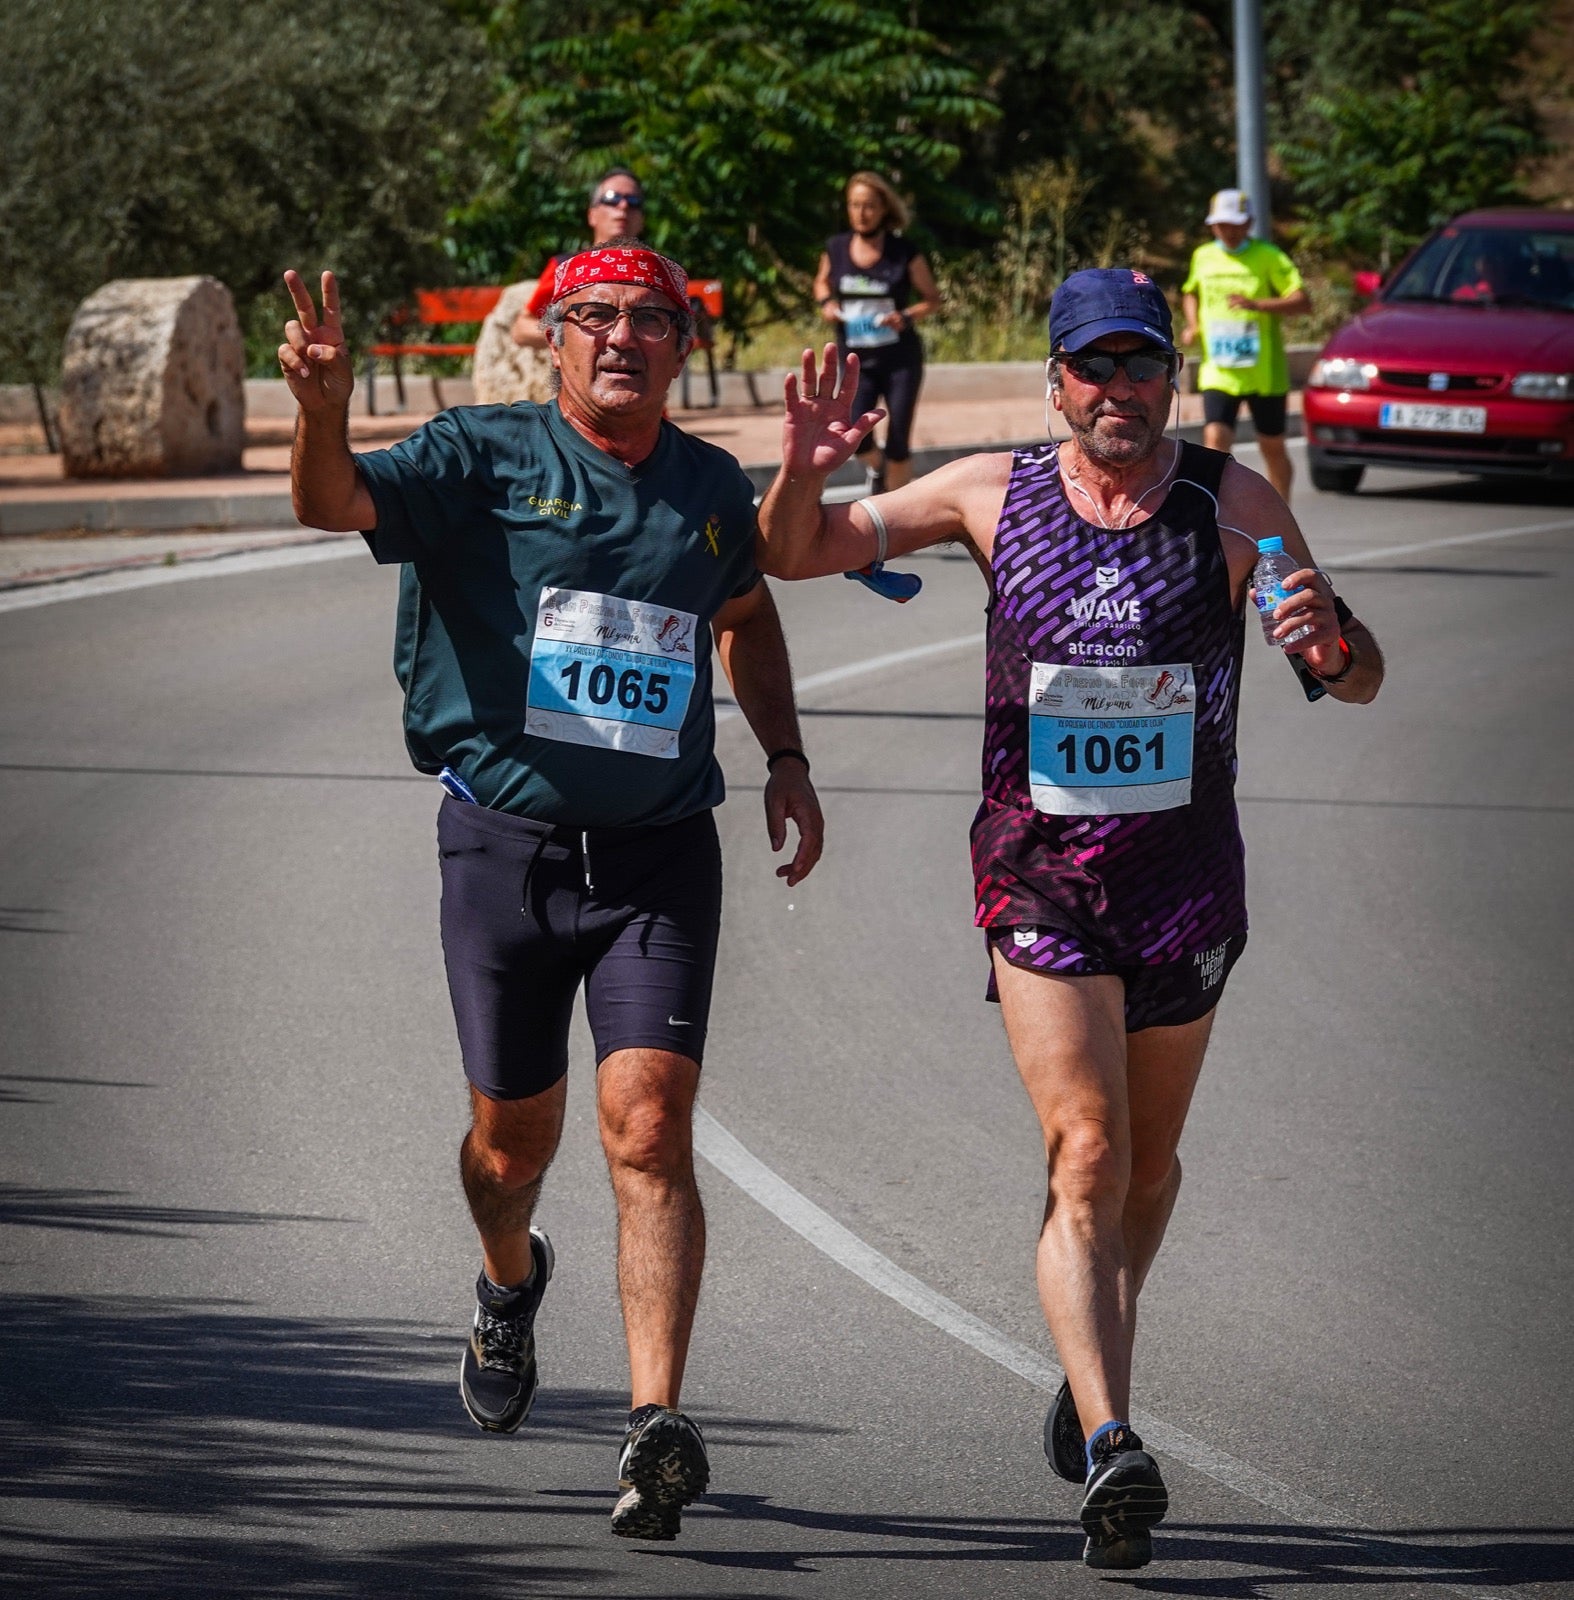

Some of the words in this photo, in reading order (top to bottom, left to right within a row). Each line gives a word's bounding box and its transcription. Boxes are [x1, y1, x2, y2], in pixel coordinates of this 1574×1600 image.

[528, 496, 583, 512] GUARDIA
[539, 507, 569, 519] CIVIL
[1070, 597, 1141, 622] WAVE
[1074, 621, 1101, 629] EMILIO
[1104, 622, 1141, 630] CARRILLO
[574, 645, 596, 657] PRUEBA
[606, 650, 624, 661] FONDO
[561, 660, 671, 714] 1065
[1064, 673, 1102, 690] PREMIO
[1104, 678, 1119, 690] DE
[1065, 720, 1087, 729] PRUEBA
[1088, 720, 1095, 729] DE
[1097, 720, 1116, 730] FONDO
[1141, 719, 1148, 728] DE
[1057, 732, 1164, 774] 1061
